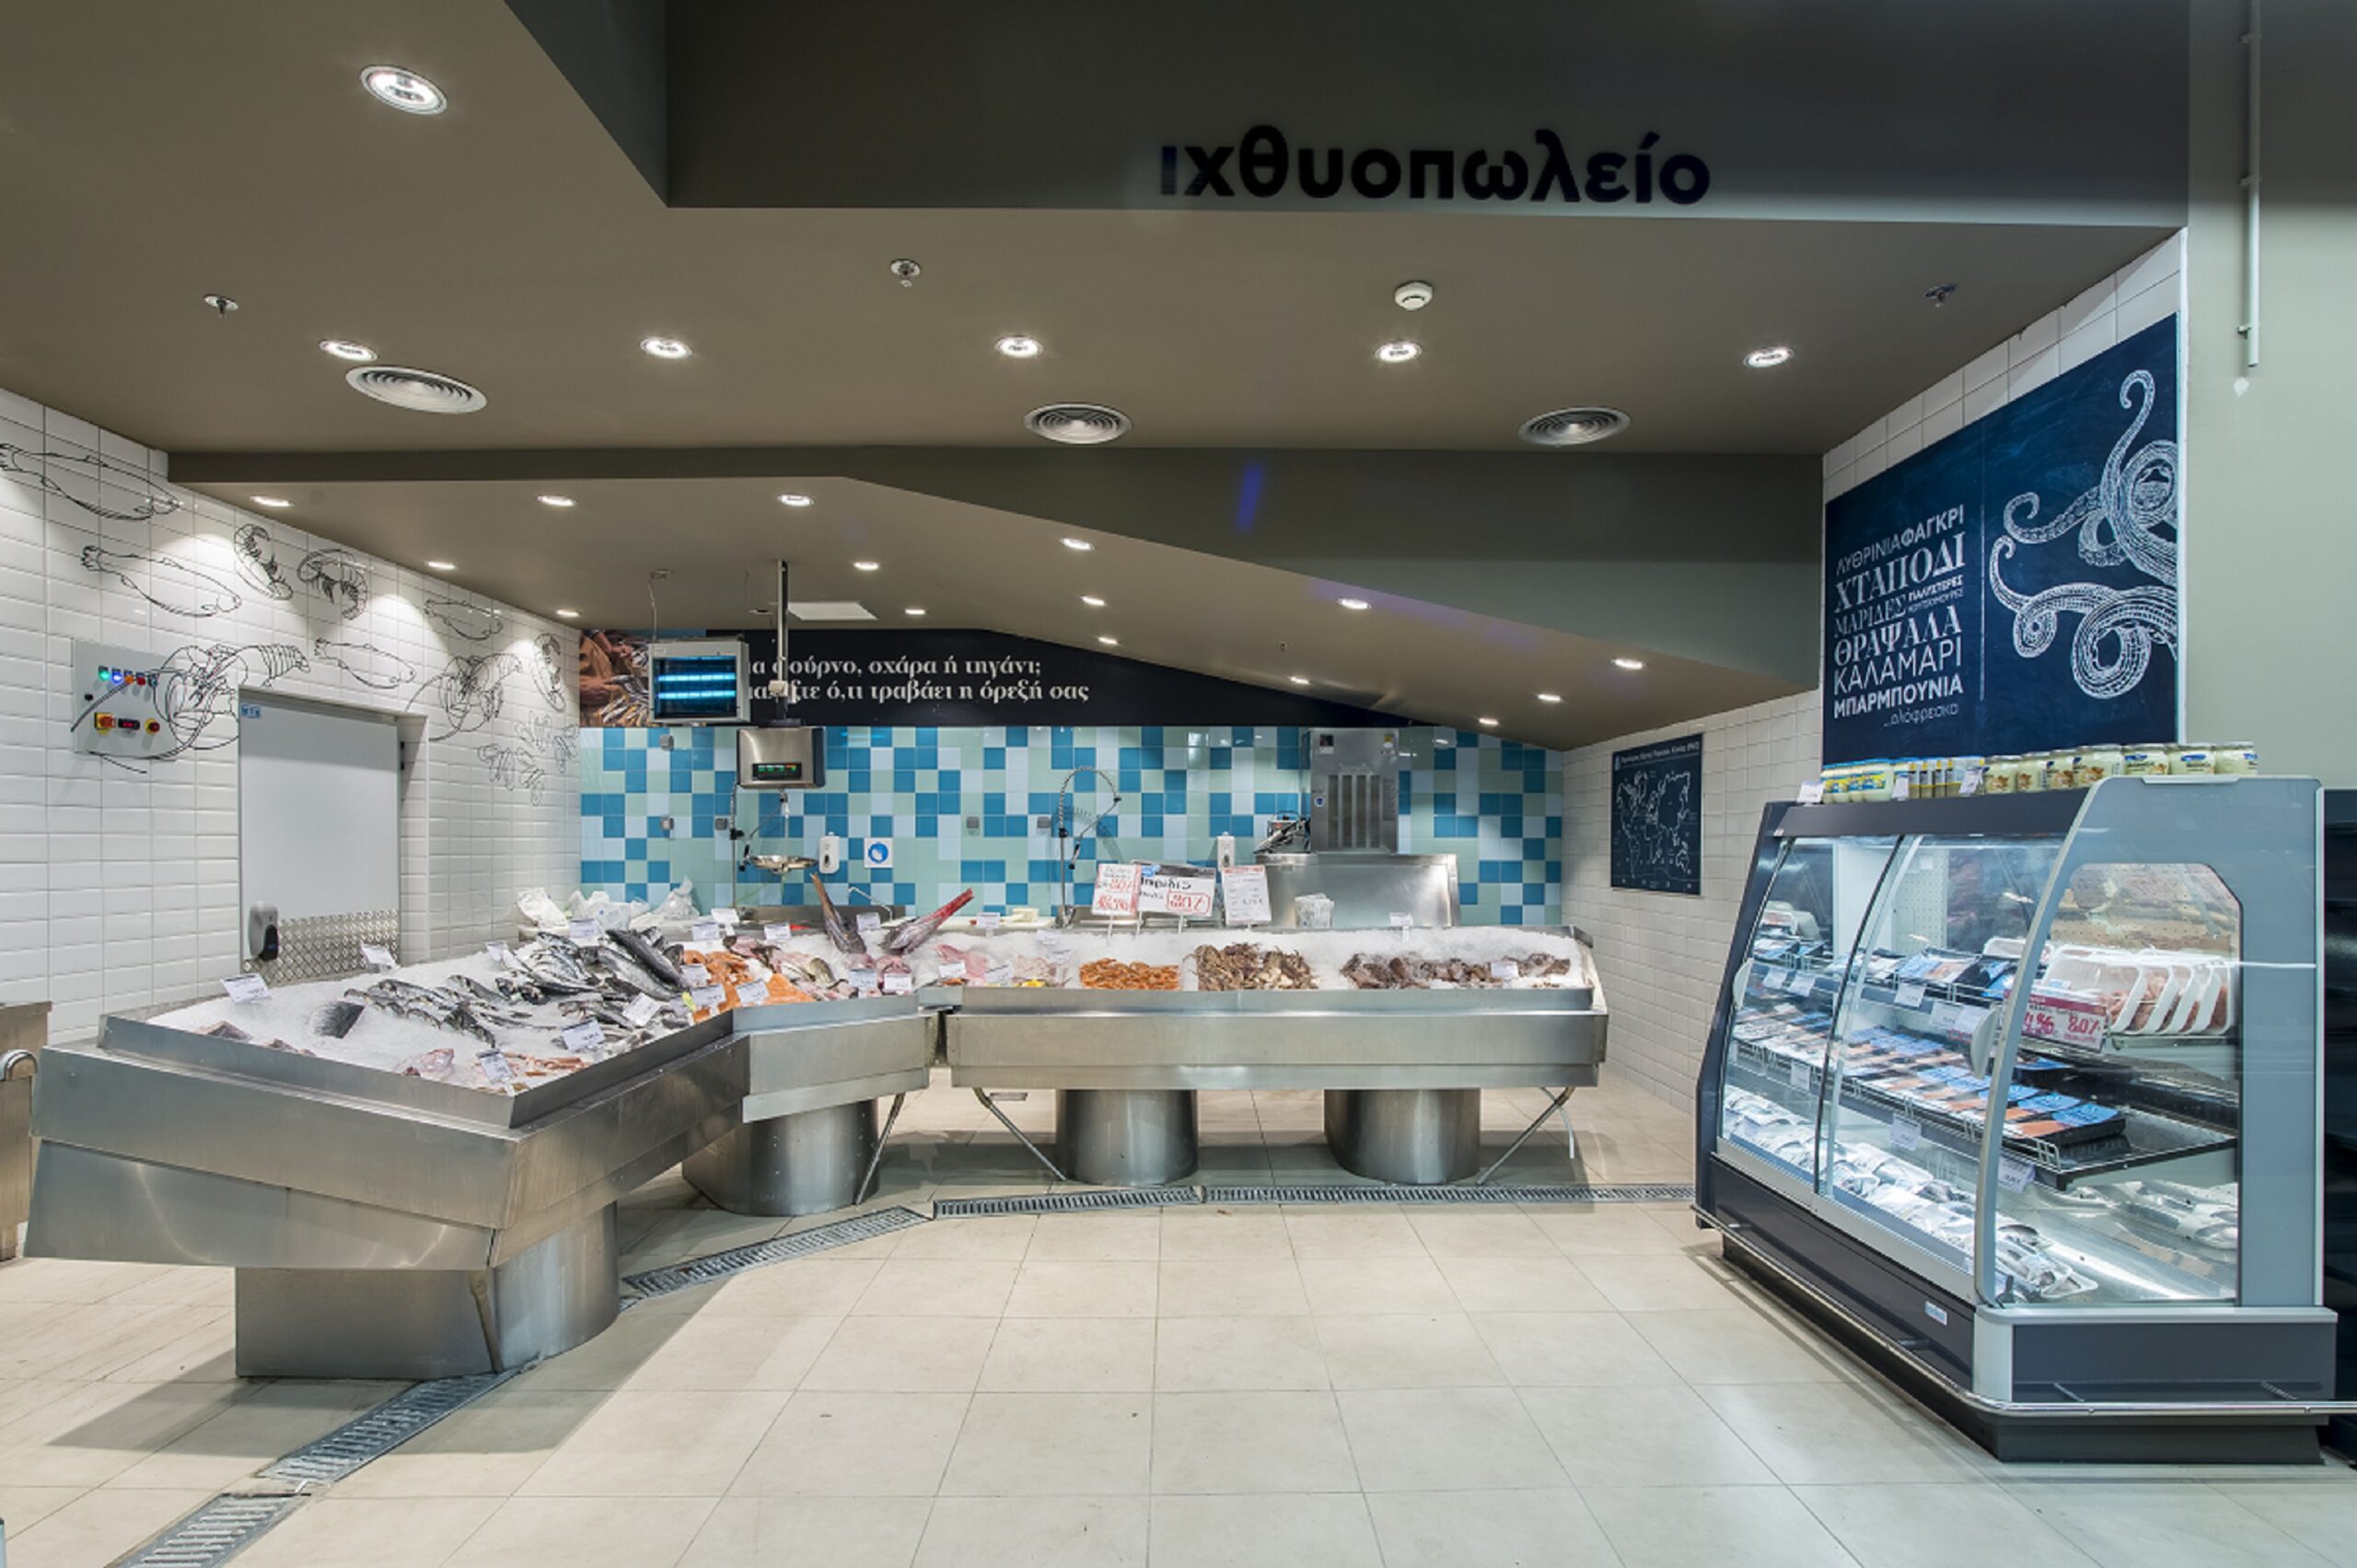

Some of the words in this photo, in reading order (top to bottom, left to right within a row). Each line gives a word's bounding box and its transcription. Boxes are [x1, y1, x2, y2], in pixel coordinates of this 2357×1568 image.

[1159, 124, 1711, 204] ιχθυοπωλείο
[1834, 531, 1966, 612] ΧΤΑΠΟΔΙ
[944, 655, 958, 674] ή
[980, 679, 1042, 703] όρεξή
[1050, 685, 1089, 703] σας
[1833, 635, 1961, 695] ΚΑΛΑΜΑΡΙ
[1833, 673, 1963, 719] ΜΠΑΡΜΠΟΥΝΙΑ
